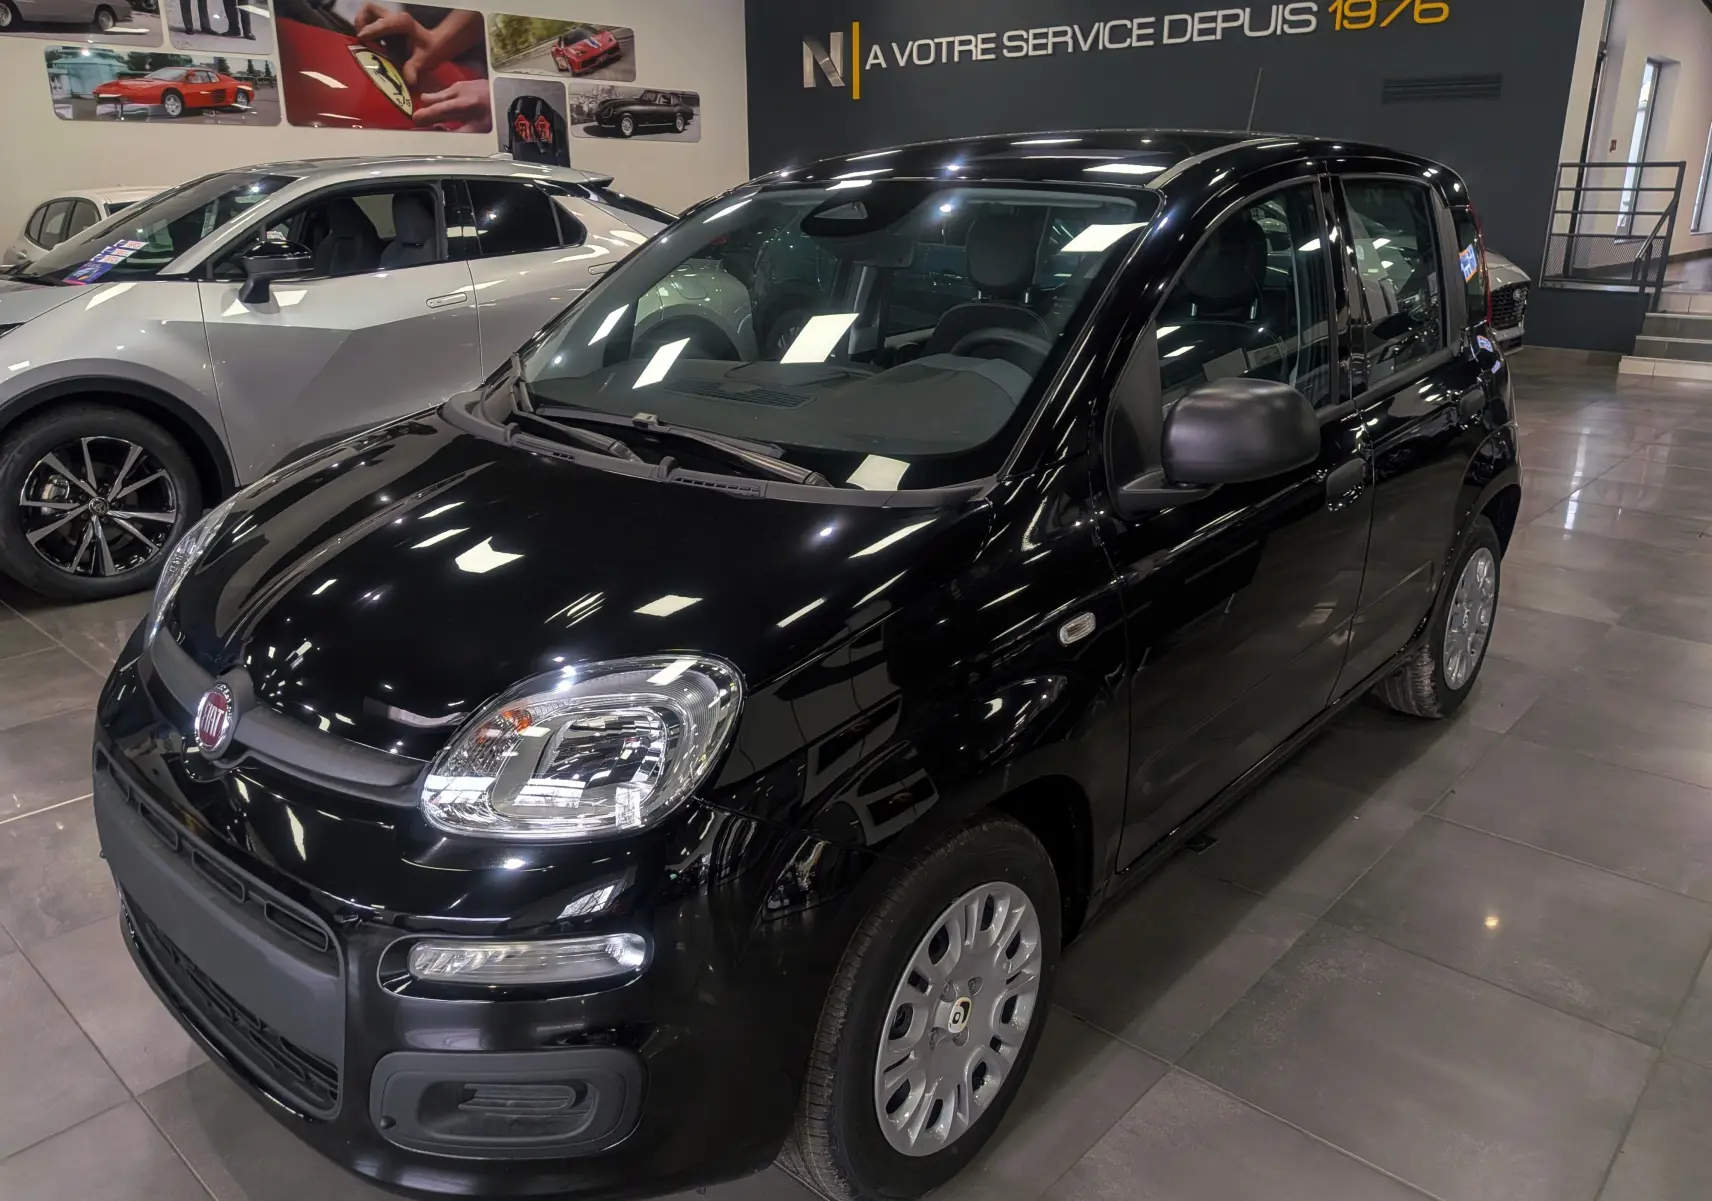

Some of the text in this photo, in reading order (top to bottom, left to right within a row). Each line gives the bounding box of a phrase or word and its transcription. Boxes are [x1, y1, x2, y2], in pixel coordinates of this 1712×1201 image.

[865, 0, 1450, 70] A VOTRE SERVICE DEPUIS 1976
[201, 701, 224, 738] FIAT
